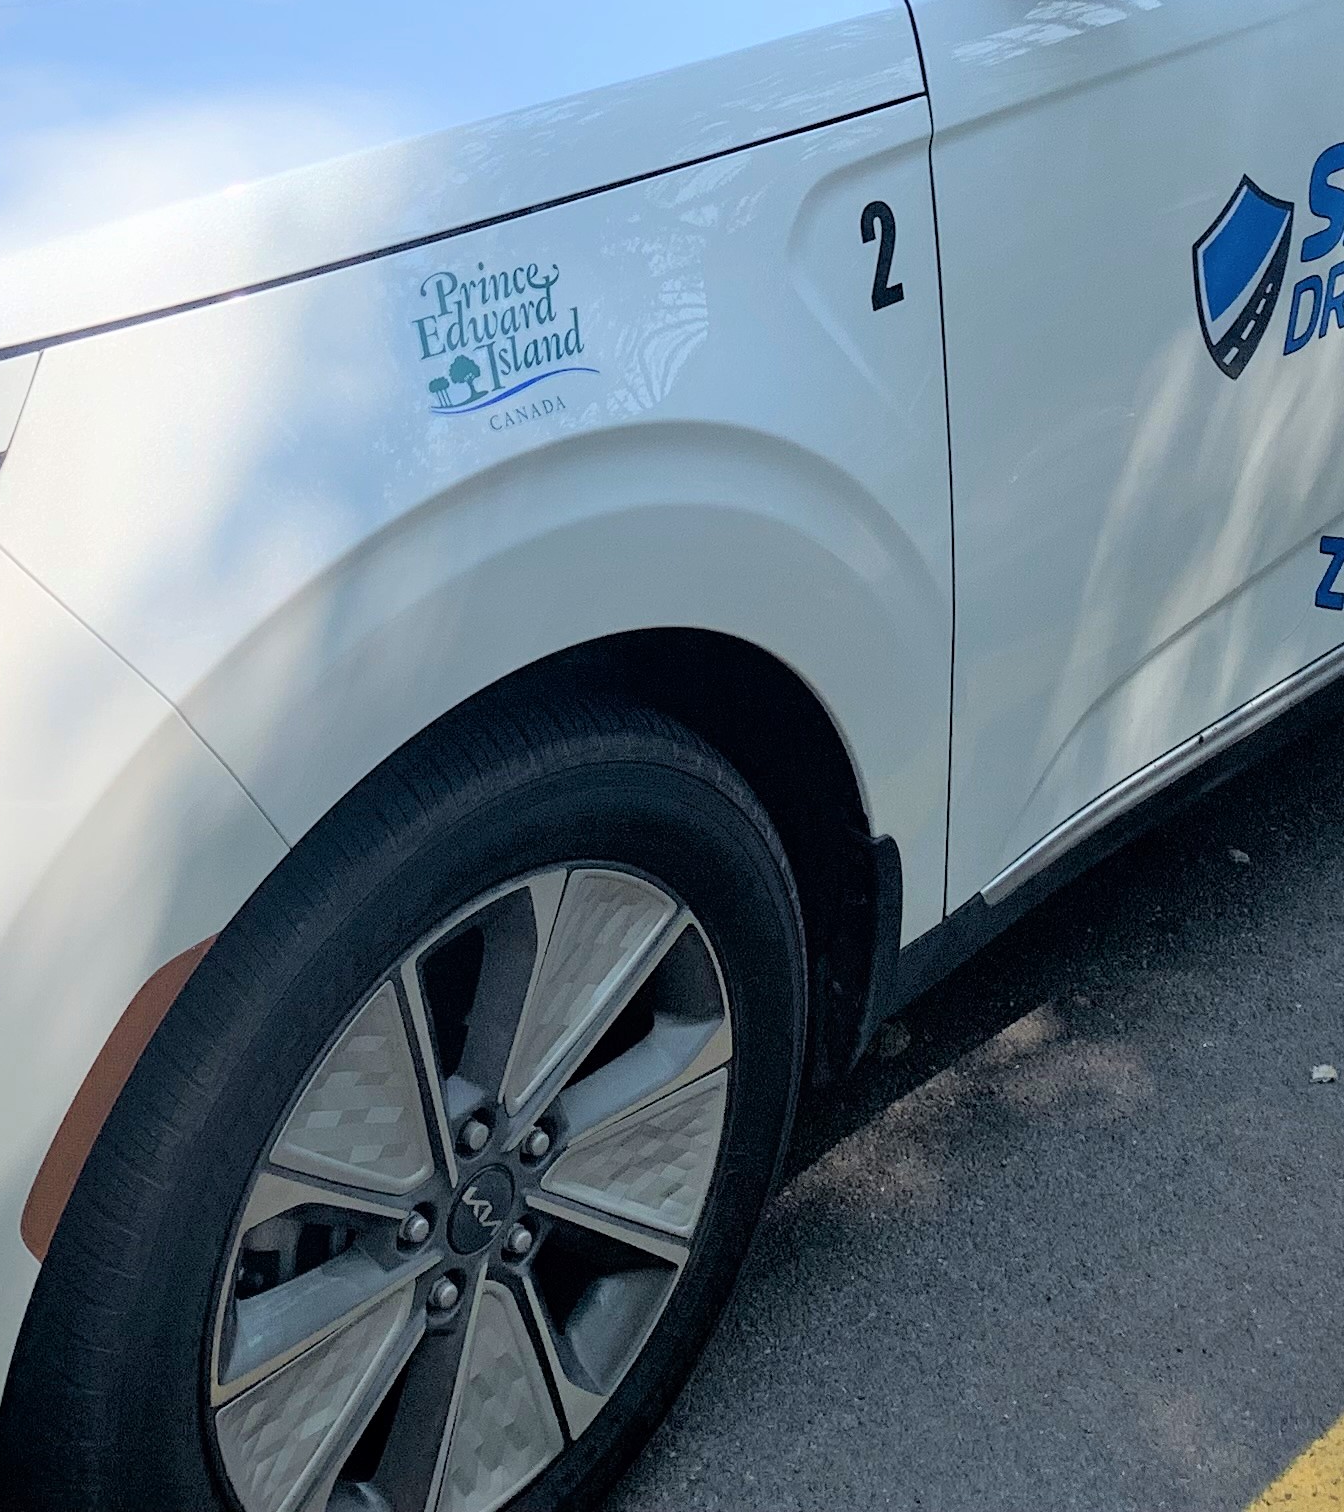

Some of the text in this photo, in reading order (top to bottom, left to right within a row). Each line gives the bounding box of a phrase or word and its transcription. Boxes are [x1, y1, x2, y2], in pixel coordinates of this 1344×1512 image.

[419, 261, 560, 318] Prince
[859, 200, 905, 312] 2
[411, 287, 558, 360] Edward
[472, 306, 586, 391] Island
[489, 394, 567, 432] CANADA
